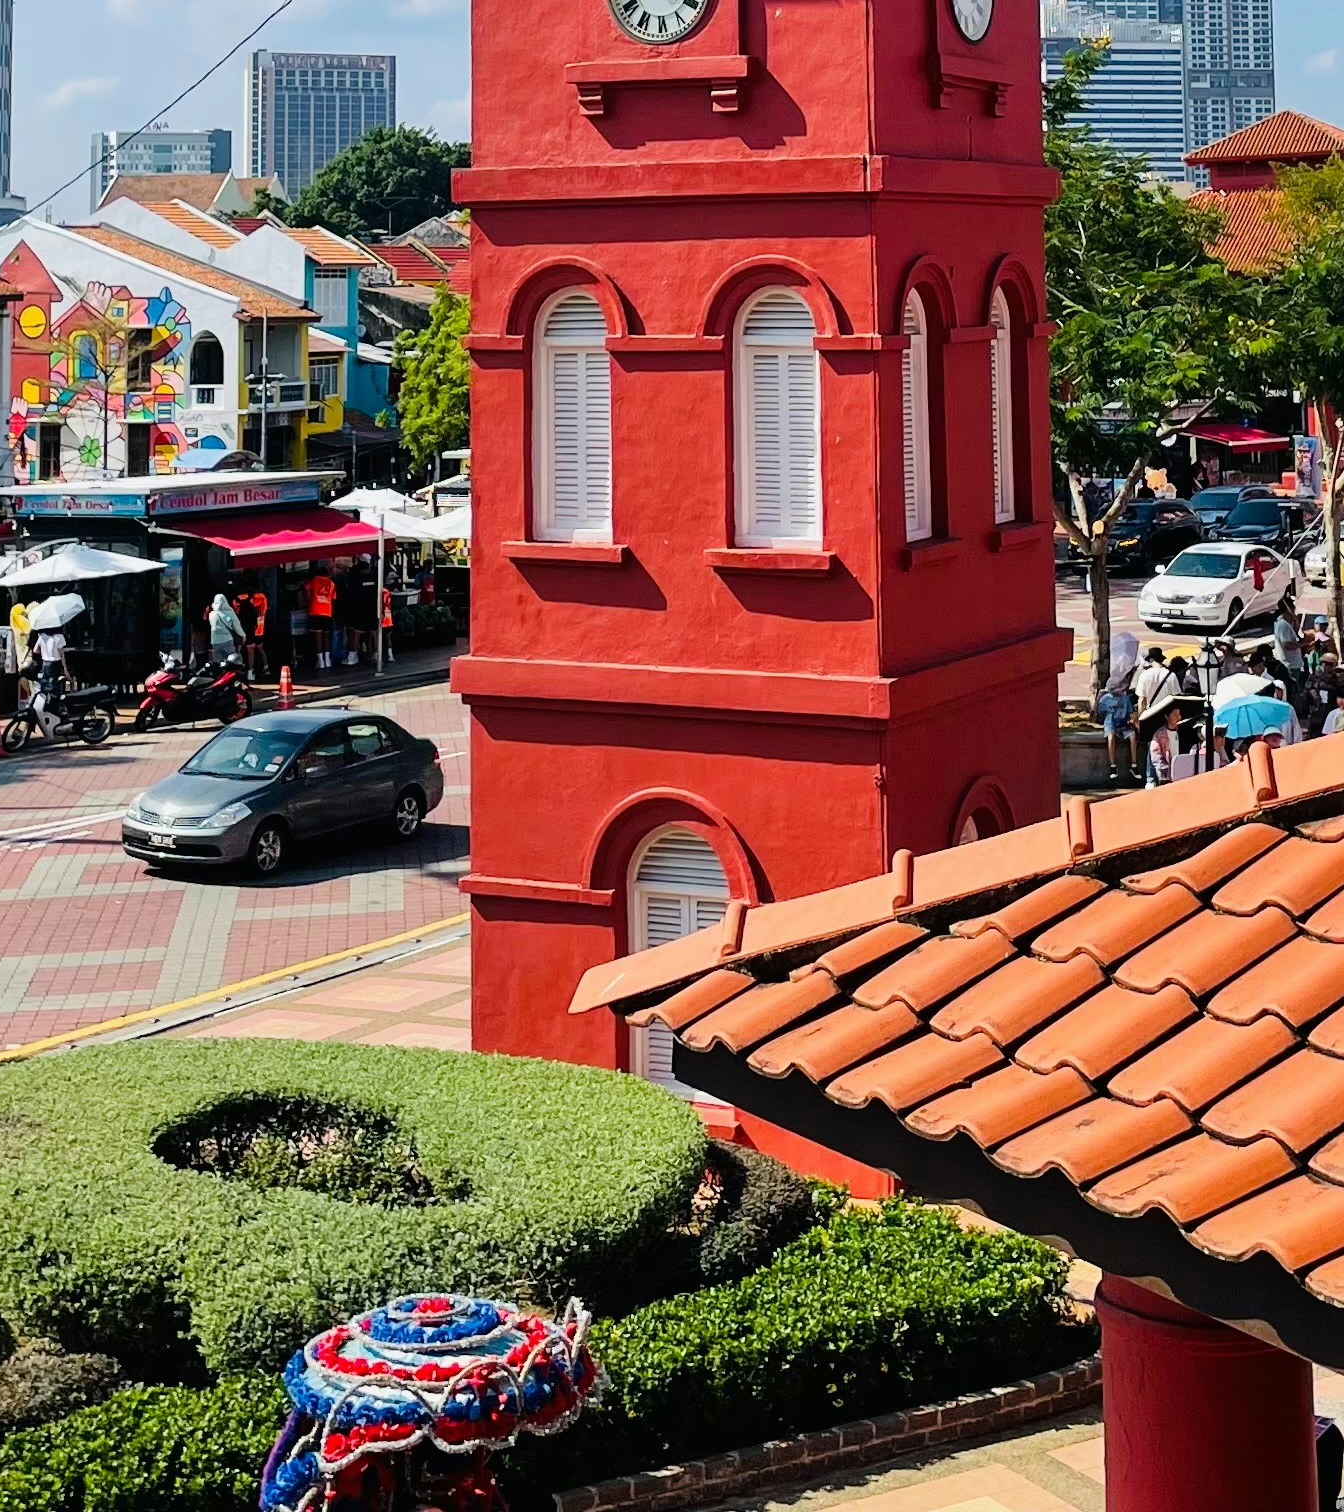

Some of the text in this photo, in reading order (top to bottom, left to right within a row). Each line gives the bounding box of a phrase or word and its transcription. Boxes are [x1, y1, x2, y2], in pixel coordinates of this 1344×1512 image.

[160, 493, 207, 510] Cendol
[212, 491, 239, 505] Jam
[243, 488, 280, 503] Besar
